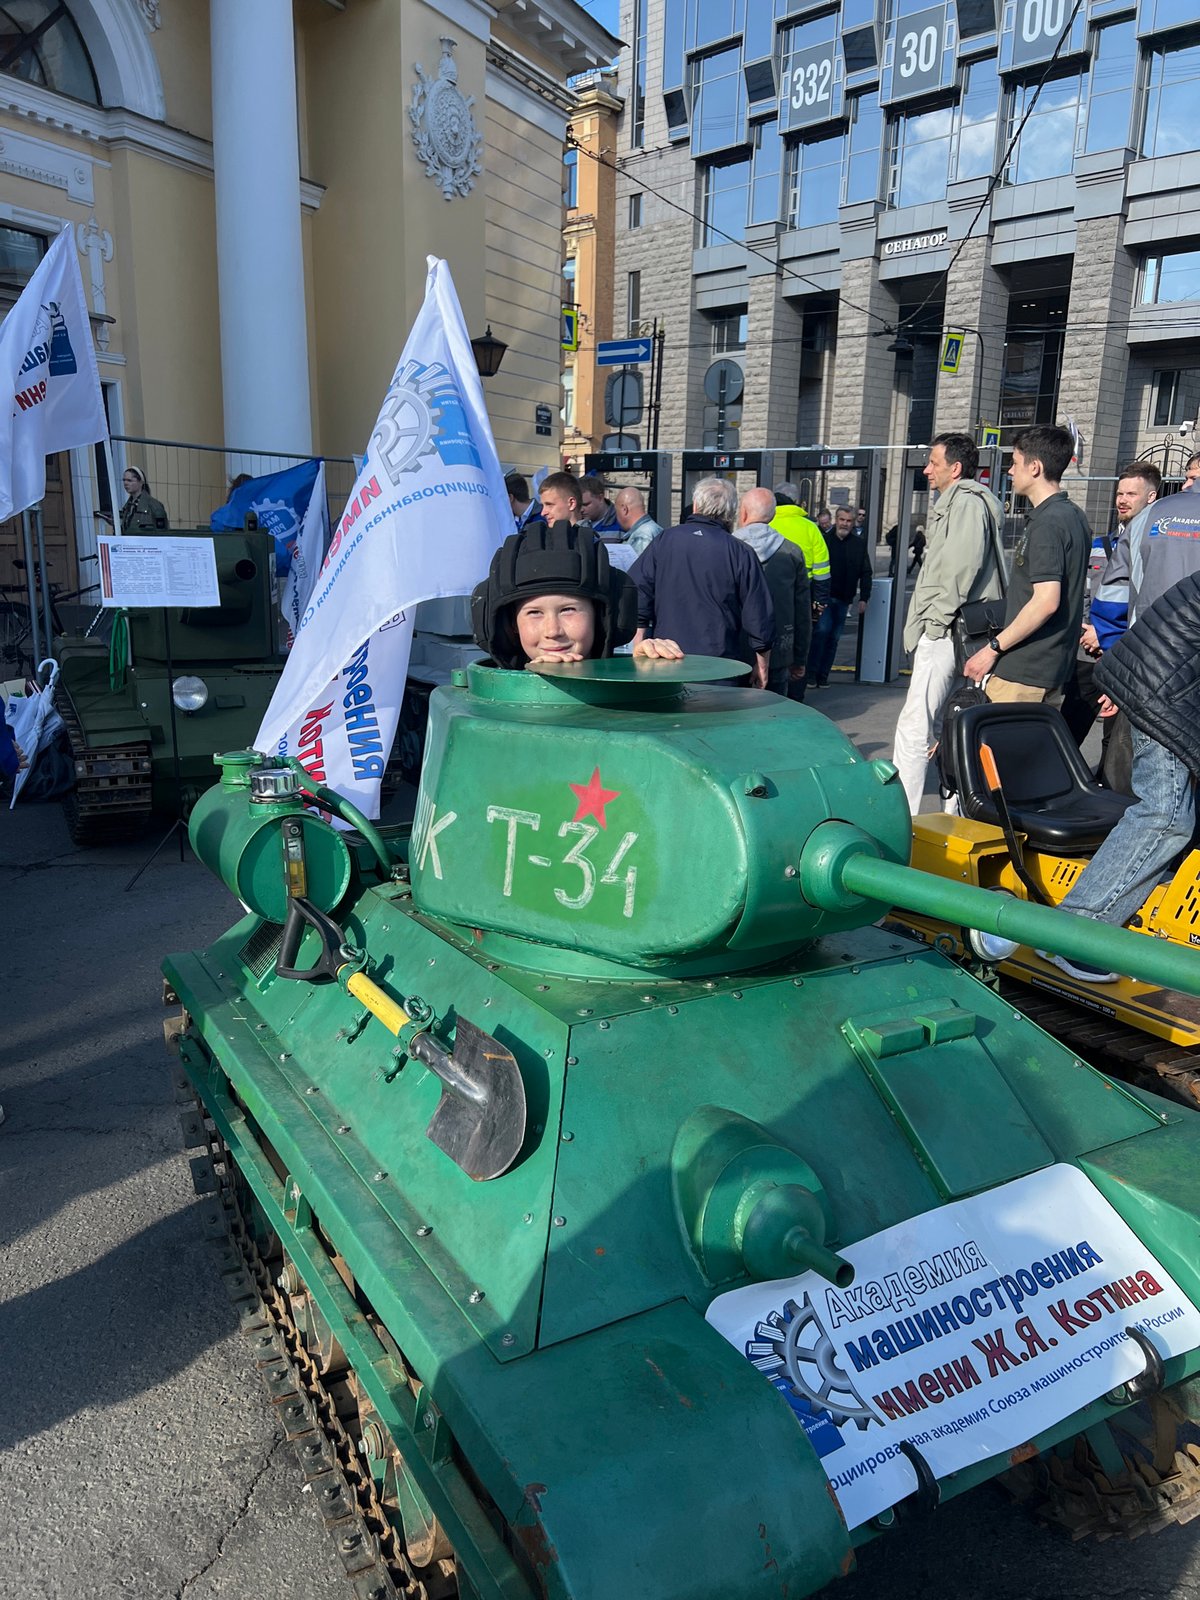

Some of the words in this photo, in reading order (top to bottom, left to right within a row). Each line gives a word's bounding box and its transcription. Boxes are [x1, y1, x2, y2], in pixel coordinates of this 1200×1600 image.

[791, 58, 832, 110] 332
[900, 25, 938, 78] 30
[884, 232, 948, 254] СЕНАТОР
[487, 805, 639, 918] Т-34
[825, 1241, 987, 1329] Академия
[845, 1241, 1103, 1372] машиностроения
[830, 1432, 932, 1491] оциированая
[931, 1407, 990, 1439] академия
[989, 1388, 1031, 1414] Союза
[1030, 1321, 1147, 1393] машиностроитей
[1142, 1306, 1185, 1330] России
[872, 1355, 981, 1420] имени
[972, 1316, 1059, 1378] Ж.Я.
[1047, 1270, 1164, 1336] Котина
